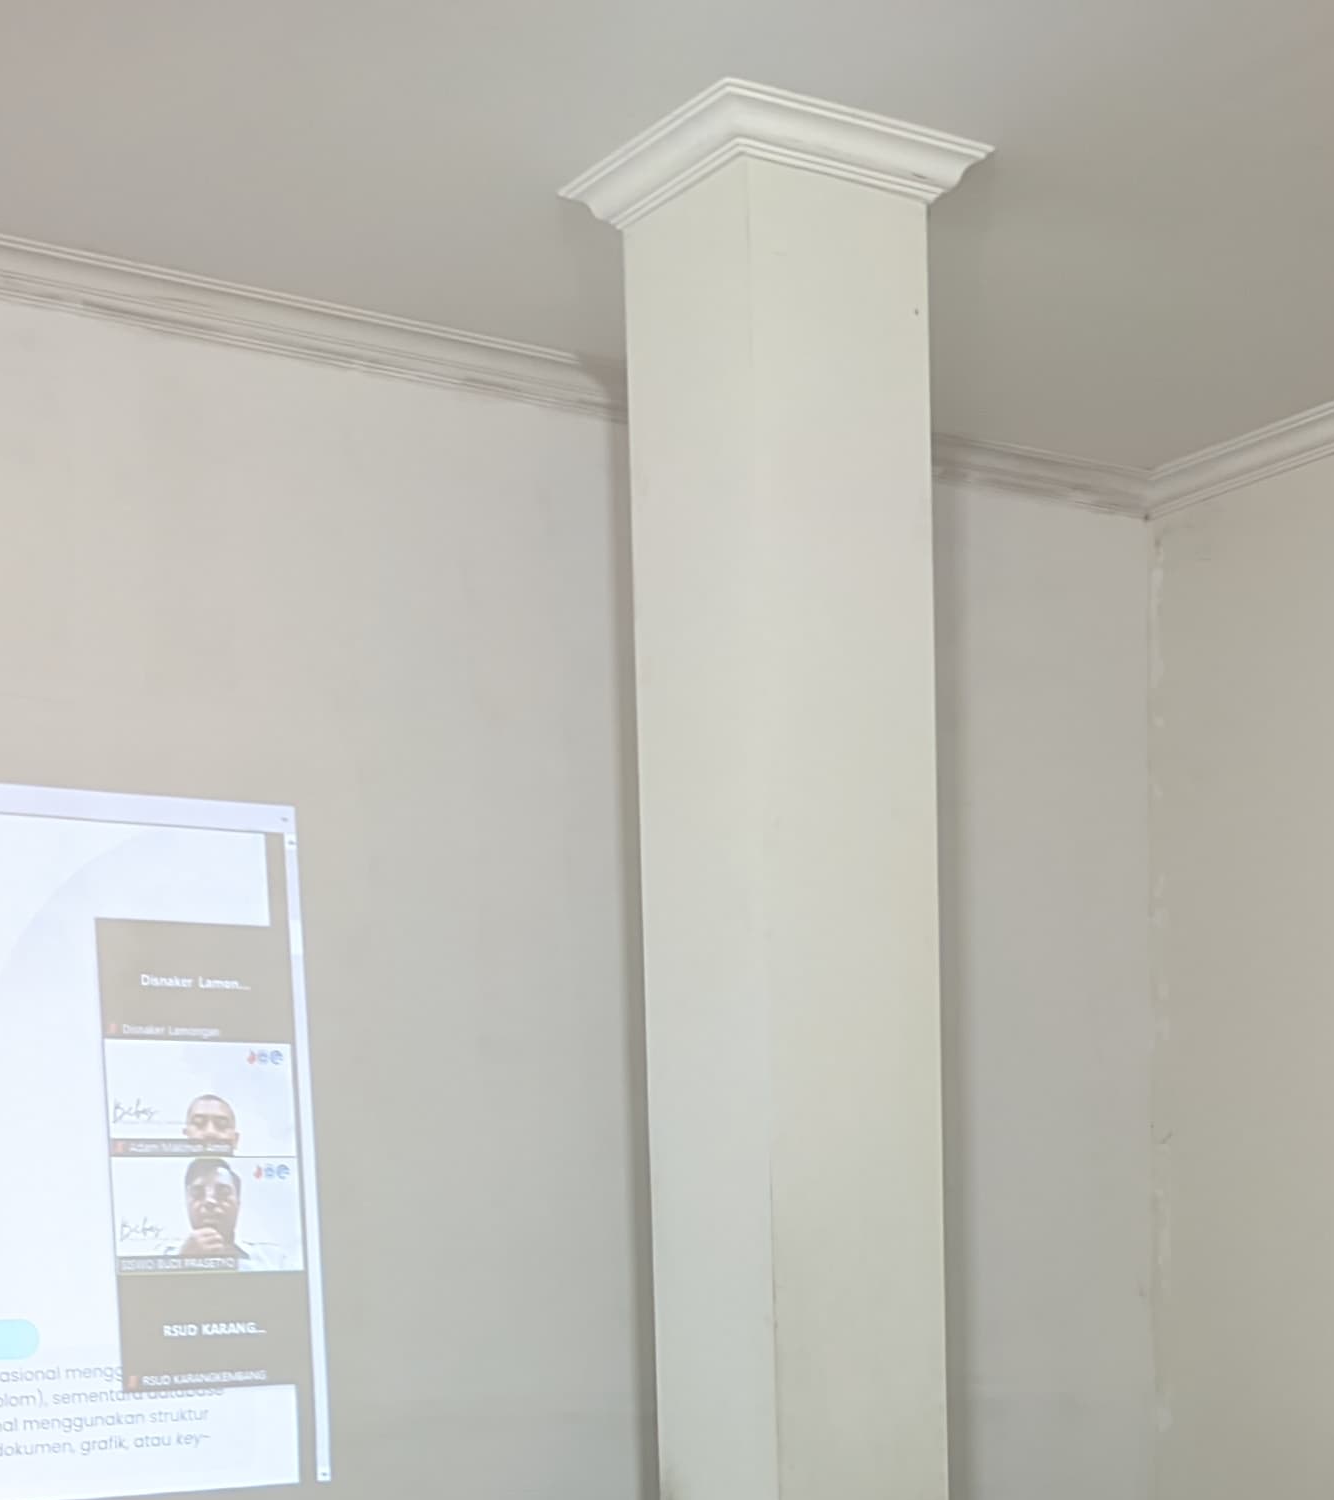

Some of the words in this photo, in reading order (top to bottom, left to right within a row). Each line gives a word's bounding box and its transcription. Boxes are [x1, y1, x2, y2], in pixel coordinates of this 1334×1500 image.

[163, 1324, 197, 1337] RSUD
[22, 1409, 145, 1436] menggunakan
[149, 1405, 209, 1425] struktur
[133, 1433, 172, 1451] atau
